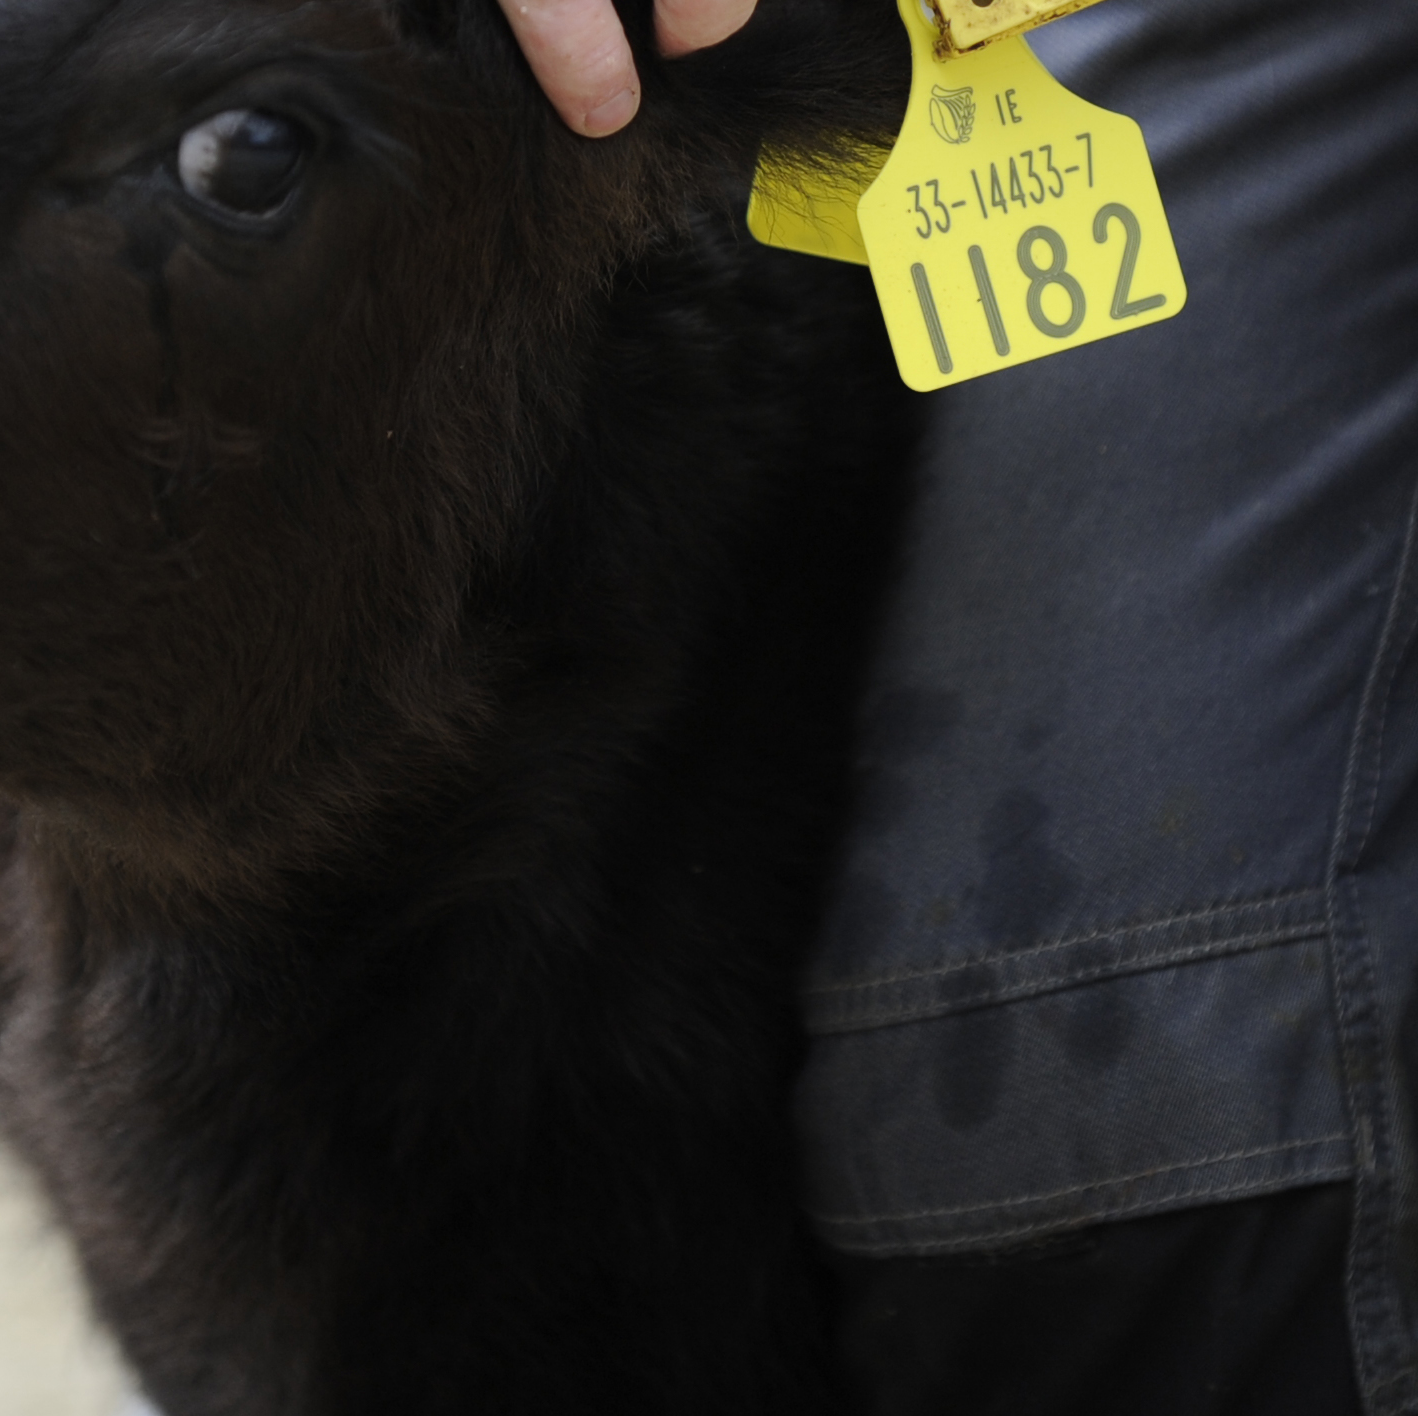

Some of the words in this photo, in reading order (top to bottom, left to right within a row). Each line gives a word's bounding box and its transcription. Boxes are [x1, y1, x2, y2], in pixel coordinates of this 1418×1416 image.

[994, 88, 1023, 127] IE
[906, 132, 1095, 239] 33-14433-7
[910, 202, 1168, 375] 1182
